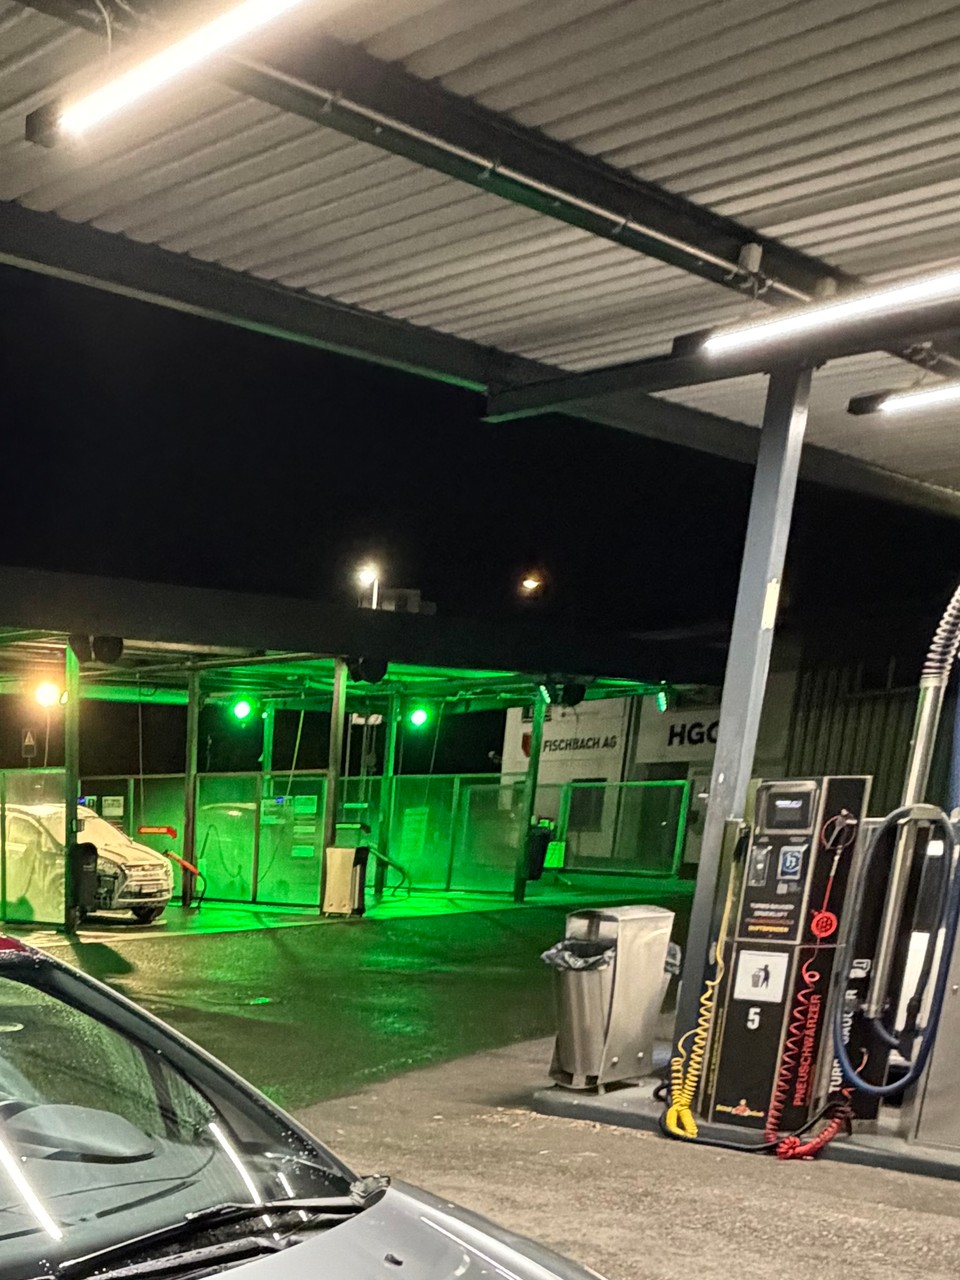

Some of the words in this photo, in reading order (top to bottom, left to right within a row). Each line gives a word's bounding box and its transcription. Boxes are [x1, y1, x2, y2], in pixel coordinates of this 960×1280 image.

[543, 738, 600, 752] FISCHBACH
[602, 735, 617, 749] AG
[746, 1007, 761, 1030] 5
